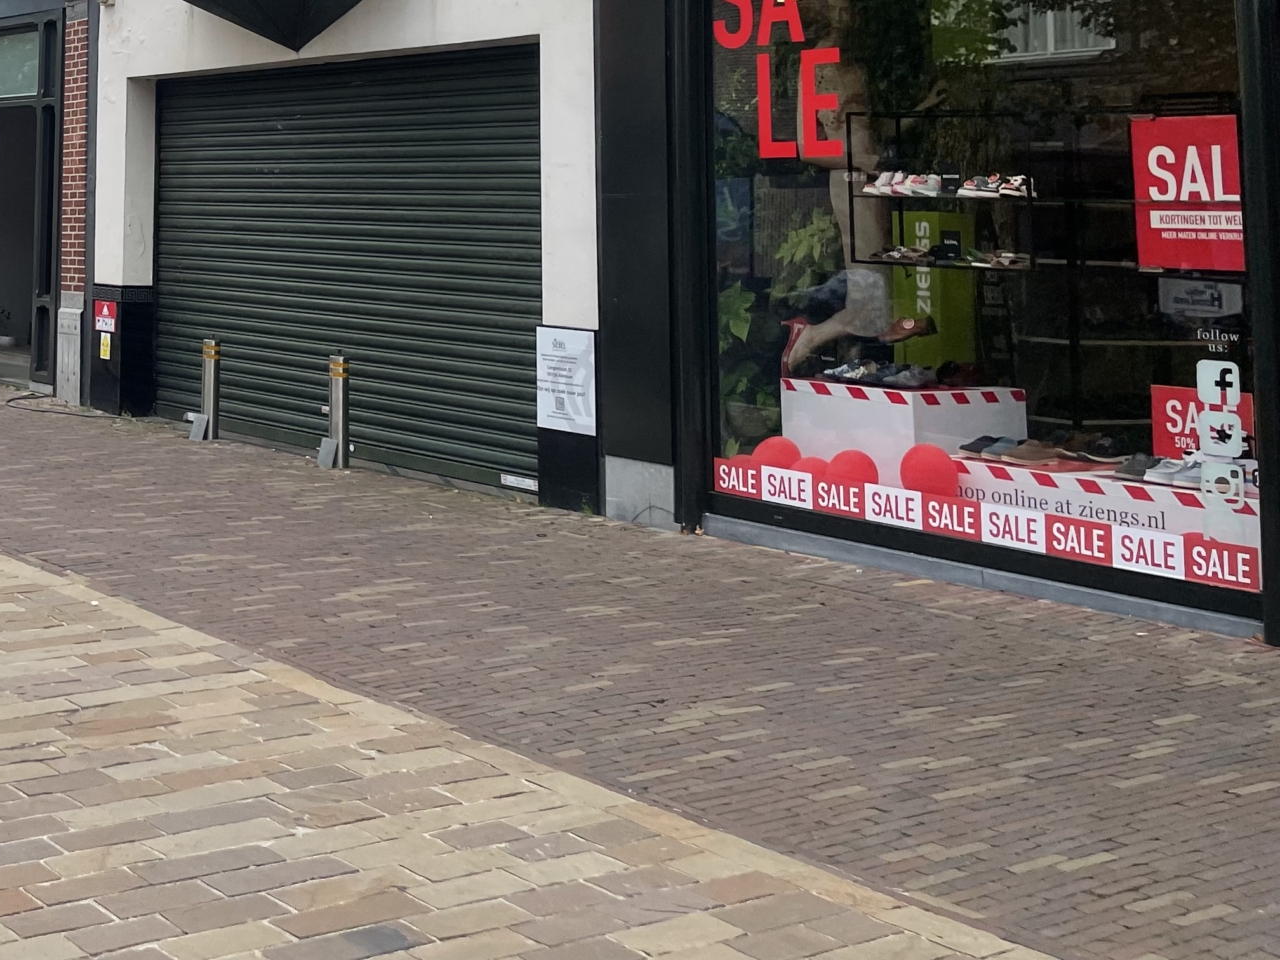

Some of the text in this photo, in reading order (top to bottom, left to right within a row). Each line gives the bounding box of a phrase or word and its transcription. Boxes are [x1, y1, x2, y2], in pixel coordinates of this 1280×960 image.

[1159, 214, 1206, 226] KORTINGEN
[1208, 215, 1222, 226] TOT
[1197, 328, 1239, 342] follow
[1208, 342, 1228, 353] us:
[1175, 436, 1196, 449] 50%
[956, 481, 1166, 529] hop online at ziengs.nl
[719, 464, 1251, 584] SALE SALE SALE SALE SALE SALE SALE SALE SALE
